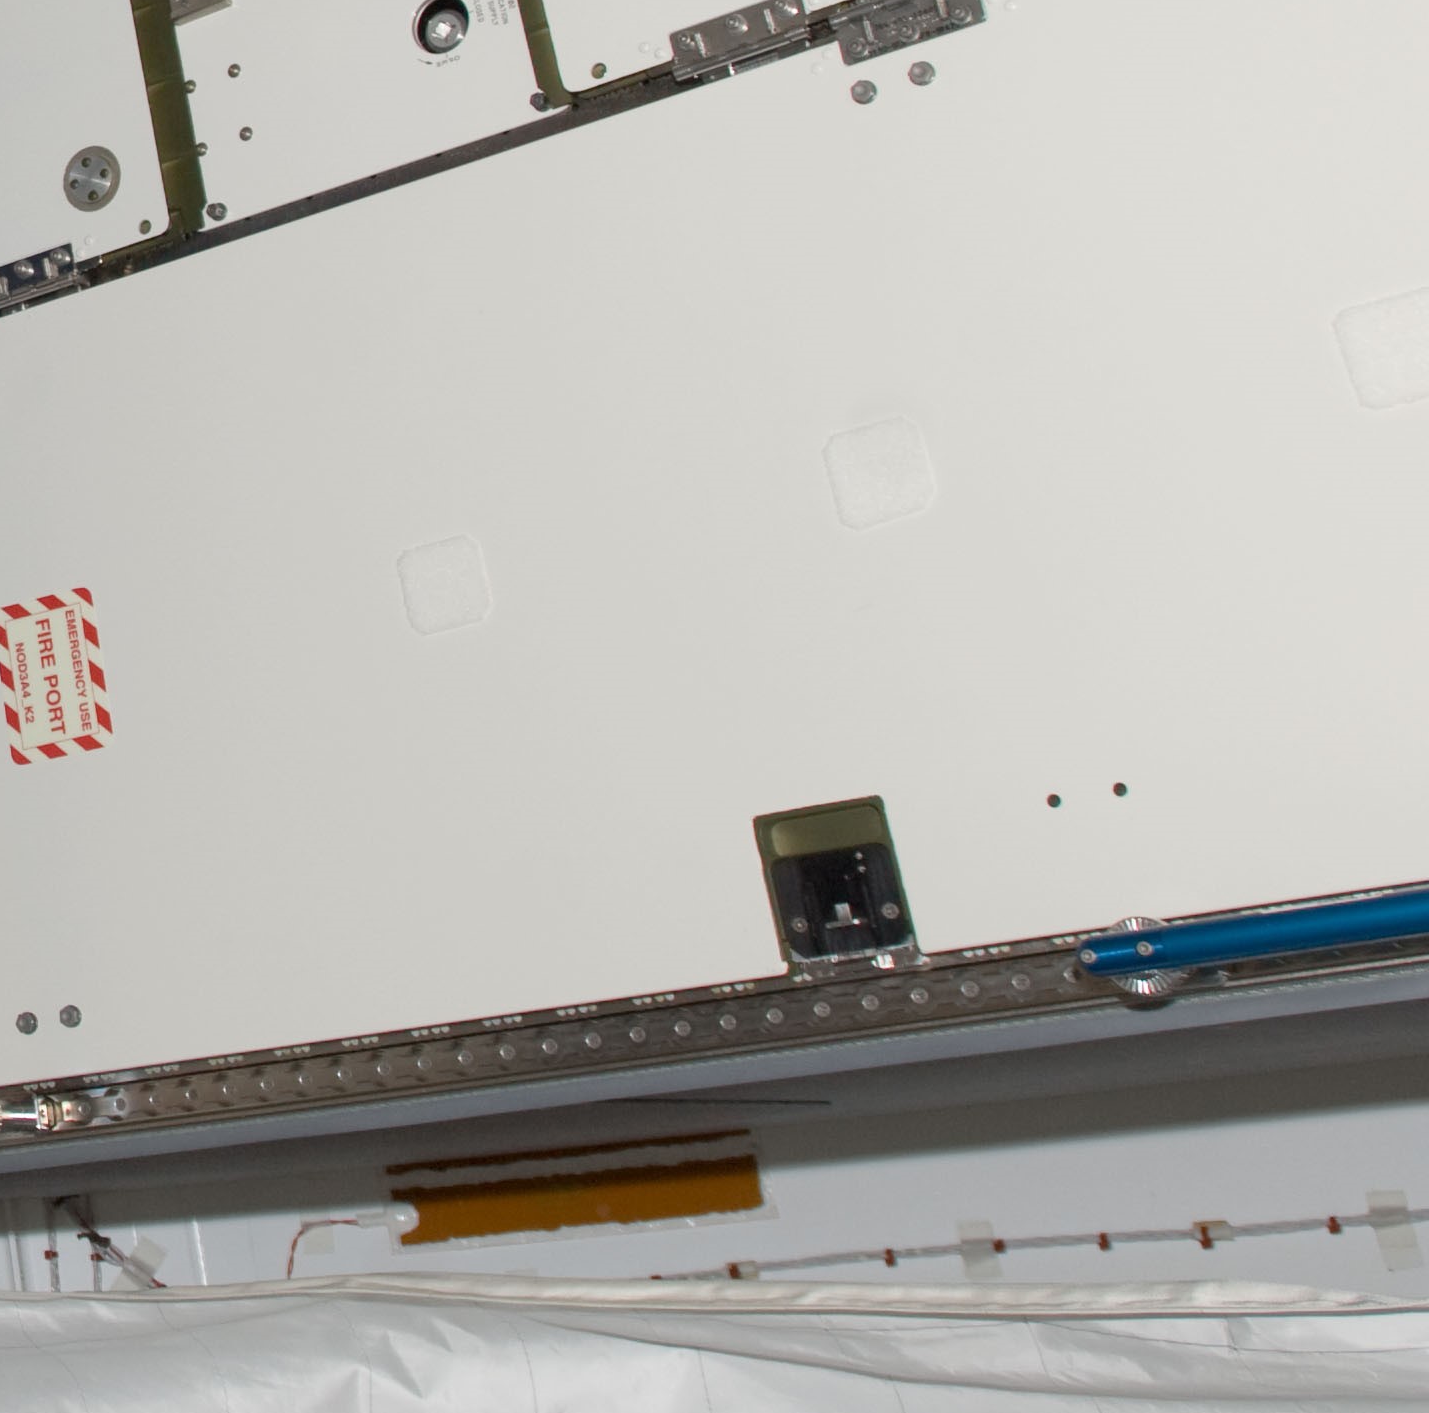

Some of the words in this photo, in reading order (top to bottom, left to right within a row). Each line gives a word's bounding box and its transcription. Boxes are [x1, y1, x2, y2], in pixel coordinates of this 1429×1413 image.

[487, 0, 498, 25] SUPPLY
[35, 618, 55, 668] FIRE
[64, 609, 86, 697] EMERGENCY
[78, 702, 92, 730] USE
[15, 642, 34, 723] NOD3A4_K2
[43, 674, 65, 733] PORT
